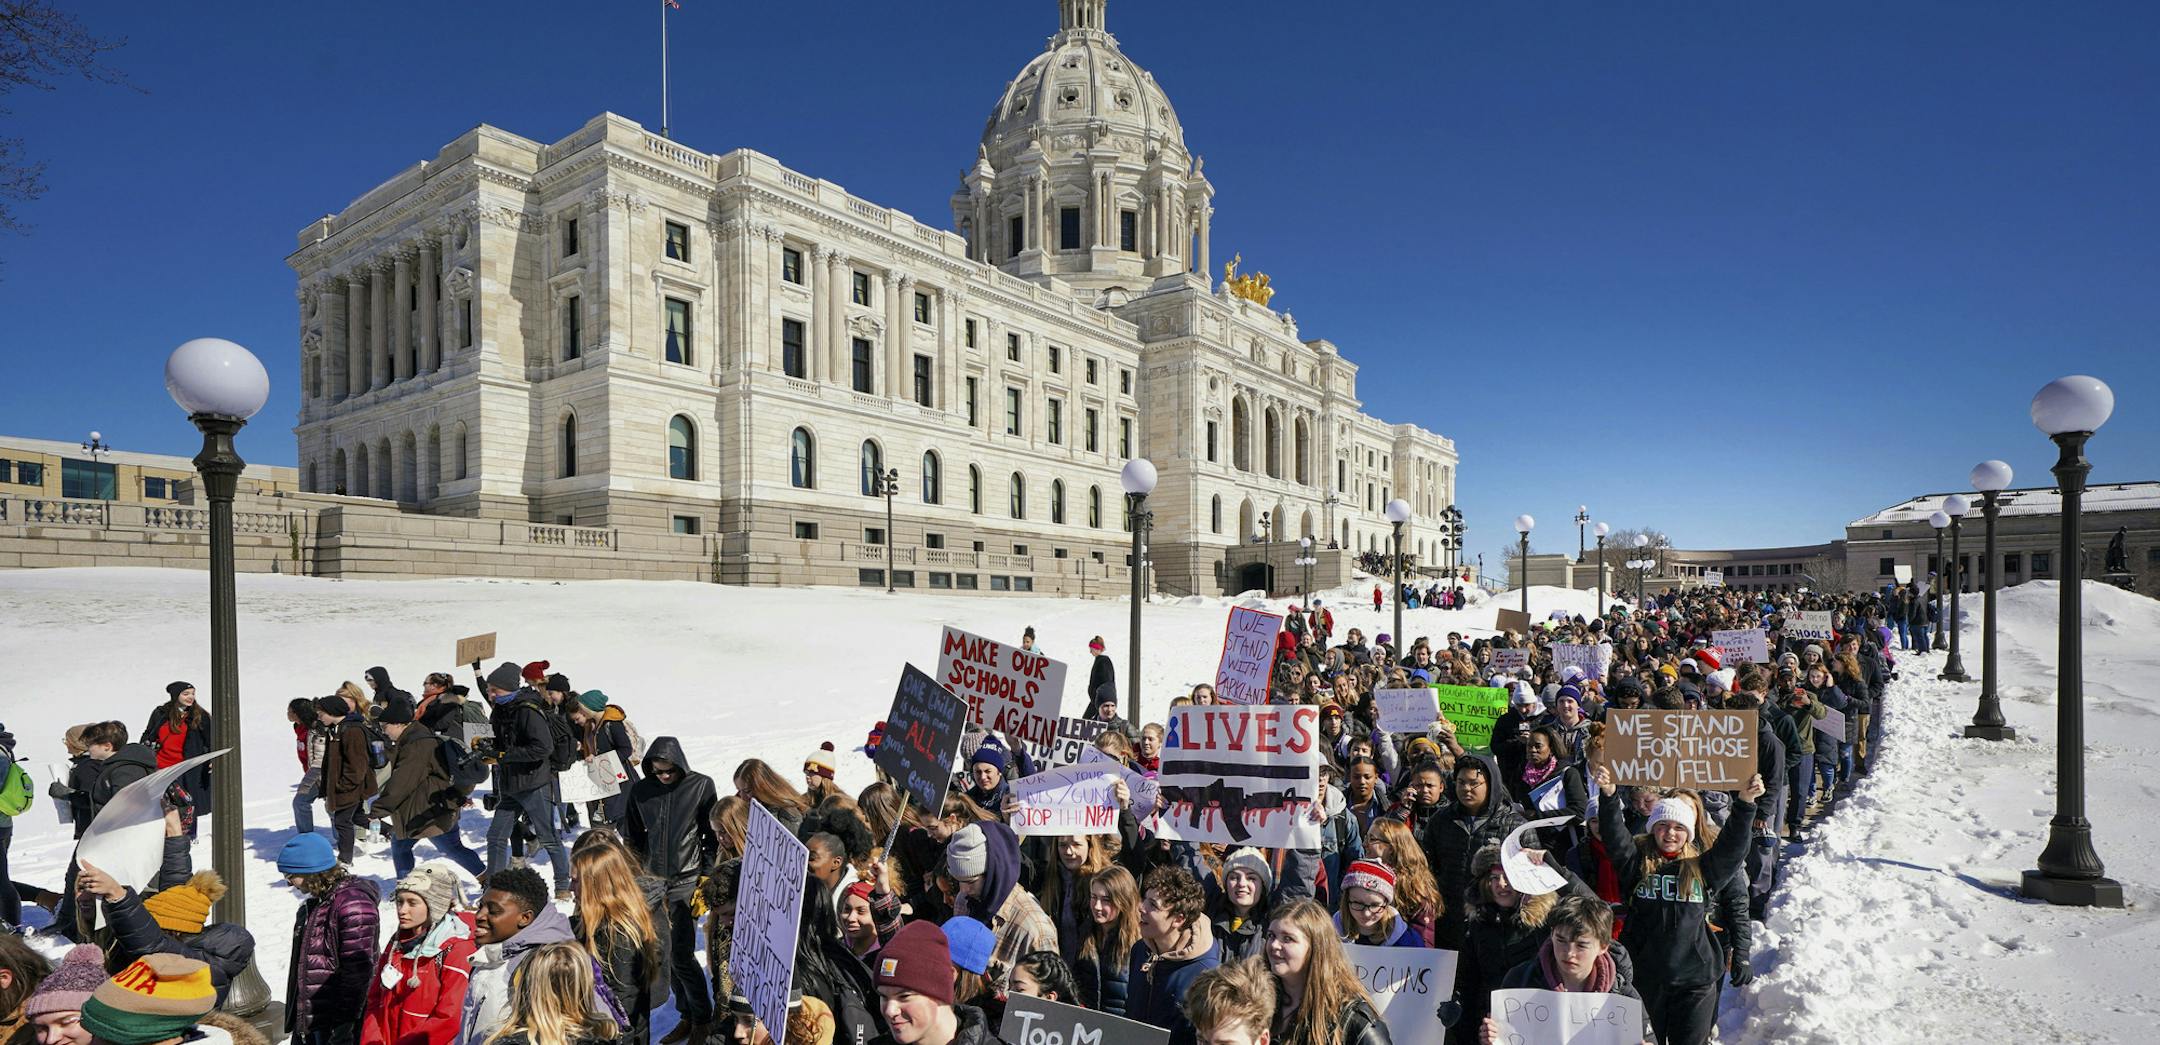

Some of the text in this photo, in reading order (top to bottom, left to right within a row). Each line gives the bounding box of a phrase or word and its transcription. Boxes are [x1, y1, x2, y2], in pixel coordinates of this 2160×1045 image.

[1239, 610, 1275, 636] WE
[943, 631, 1049, 680] MAKE OUR
[1226, 632, 1270, 661] STAND
[1228, 655, 1260, 679] WITH
[903, 673, 927, 703] ONE
[948, 658, 1039, 709] SCHOOLS
[1217, 671, 1268, 705] PARKLAND
[1440, 688, 1474, 699] HOUGHTS
[1440, 701, 1465, 713] ON'T
[1467, 704, 1486, 715] SAVE
[993, 705, 1057, 749] AGAIN
[1057, 717, 1108, 742] ILENCE
[1181, 709, 1319, 755] LIVES
[1613, 713, 1745, 738] WE STAND
[904, 719, 937, 762] ALL
[1031, 739, 1062, 760] TOP
[1636, 736, 1751, 759] FOR THOSE
[1074, 770, 1104, 782] YOUR
[1611, 758, 1739, 784] WHO FELL
[1016, 788, 1053, 805] LIVES
[1071, 785, 1114, 805] GUNS
[1014, 807, 1052, 827] STOP
[1084, 805, 1114, 828] NRA
[1372, 965, 1432, 995] GUNS
[1504, 997, 1550, 1023] Pro
